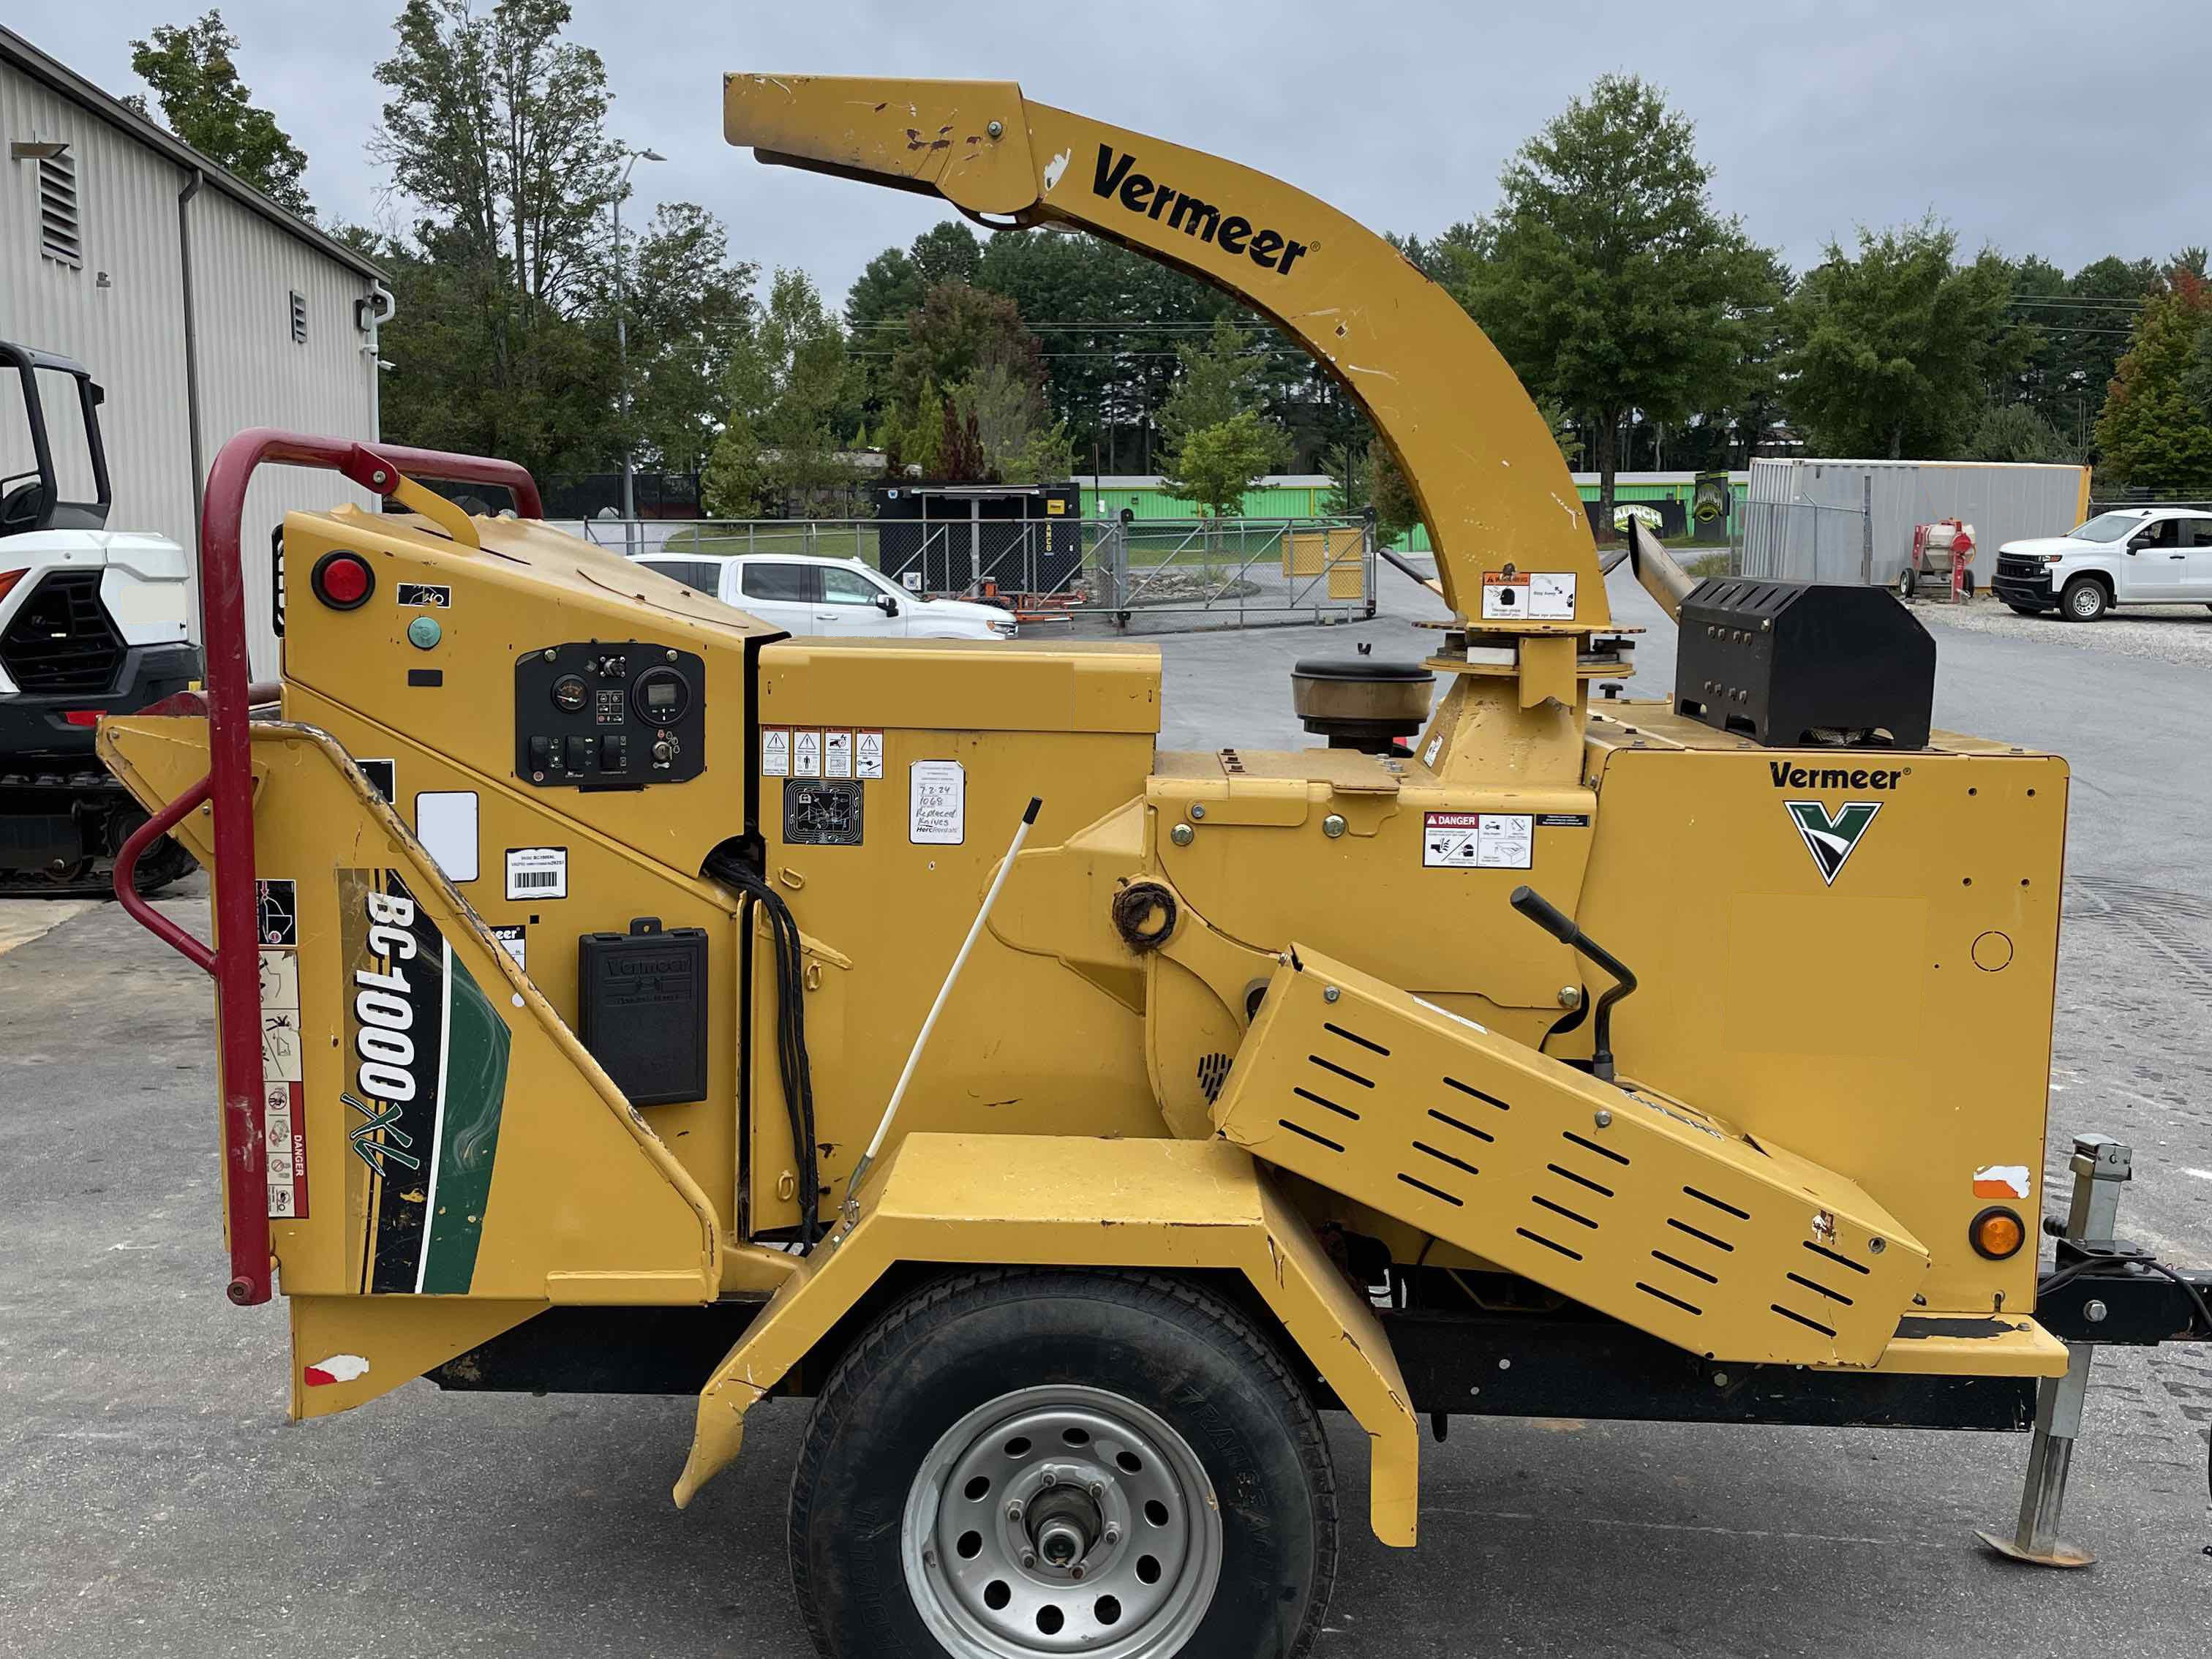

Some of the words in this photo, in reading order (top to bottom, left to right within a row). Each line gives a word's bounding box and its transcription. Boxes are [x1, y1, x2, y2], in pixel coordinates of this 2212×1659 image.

[1092, 143, 1308, 276] Vermeer
[1769, 761, 1902, 790] Vermeer
[1438, 816, 1475, 825] DANGER
[293, 1134, 304, 1177] DANGER
